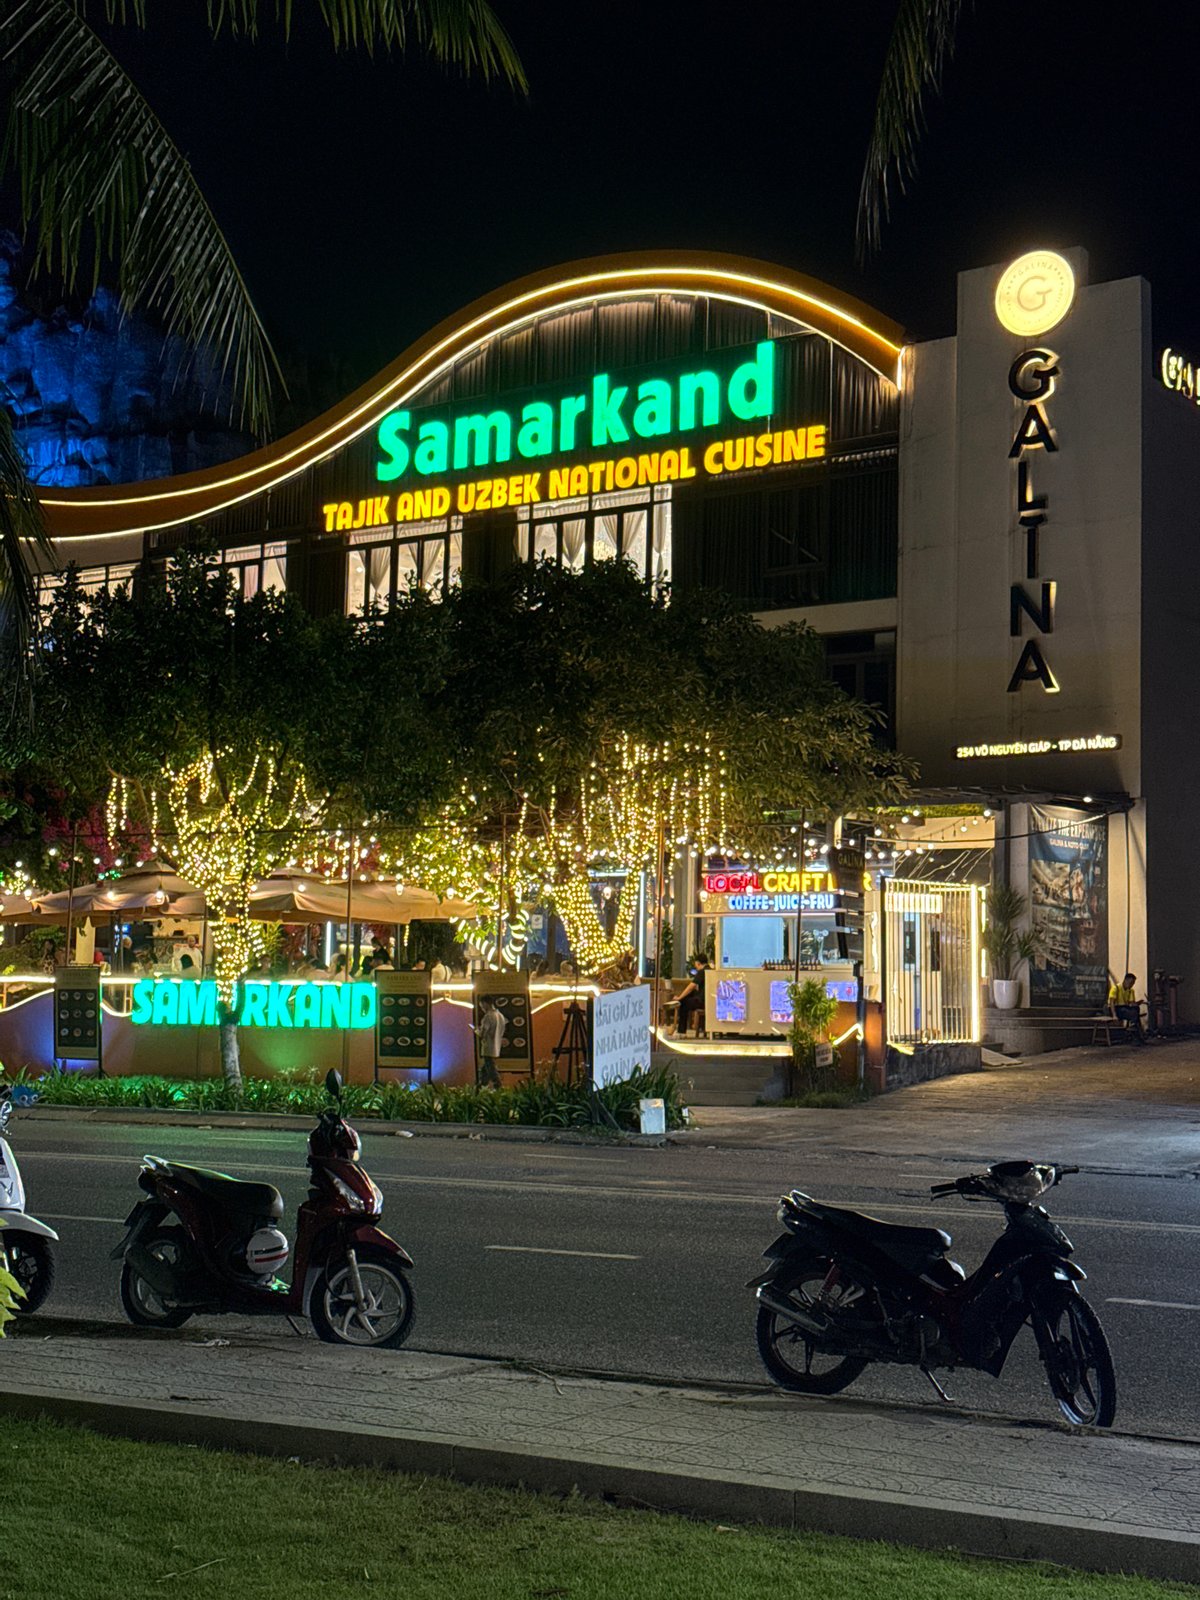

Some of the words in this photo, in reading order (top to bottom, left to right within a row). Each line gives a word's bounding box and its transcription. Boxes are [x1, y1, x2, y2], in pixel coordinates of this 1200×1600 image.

[376, 341, 775, 482] Samarkand
[322, 496, 389, 533] TAJIK
[396, 486, 451, 522] AND
[457, 472, 542, 513] UZBEK
[548, 447, 697, 501] NATIONAL
[703, 425, 827, 474] CUISINE
[957, 747, 974, 758] 254
[1058, 740, 1072, 751] TP
[705, 871, 762, 893] LOCAL
[763, 872, 824, 893] CRAFT
[132, 979, 378, 1029] SAMRKAND
[596, 1029, 617, 1056] NHÀ
[618, 1024, 648, 1049] HÀNG
